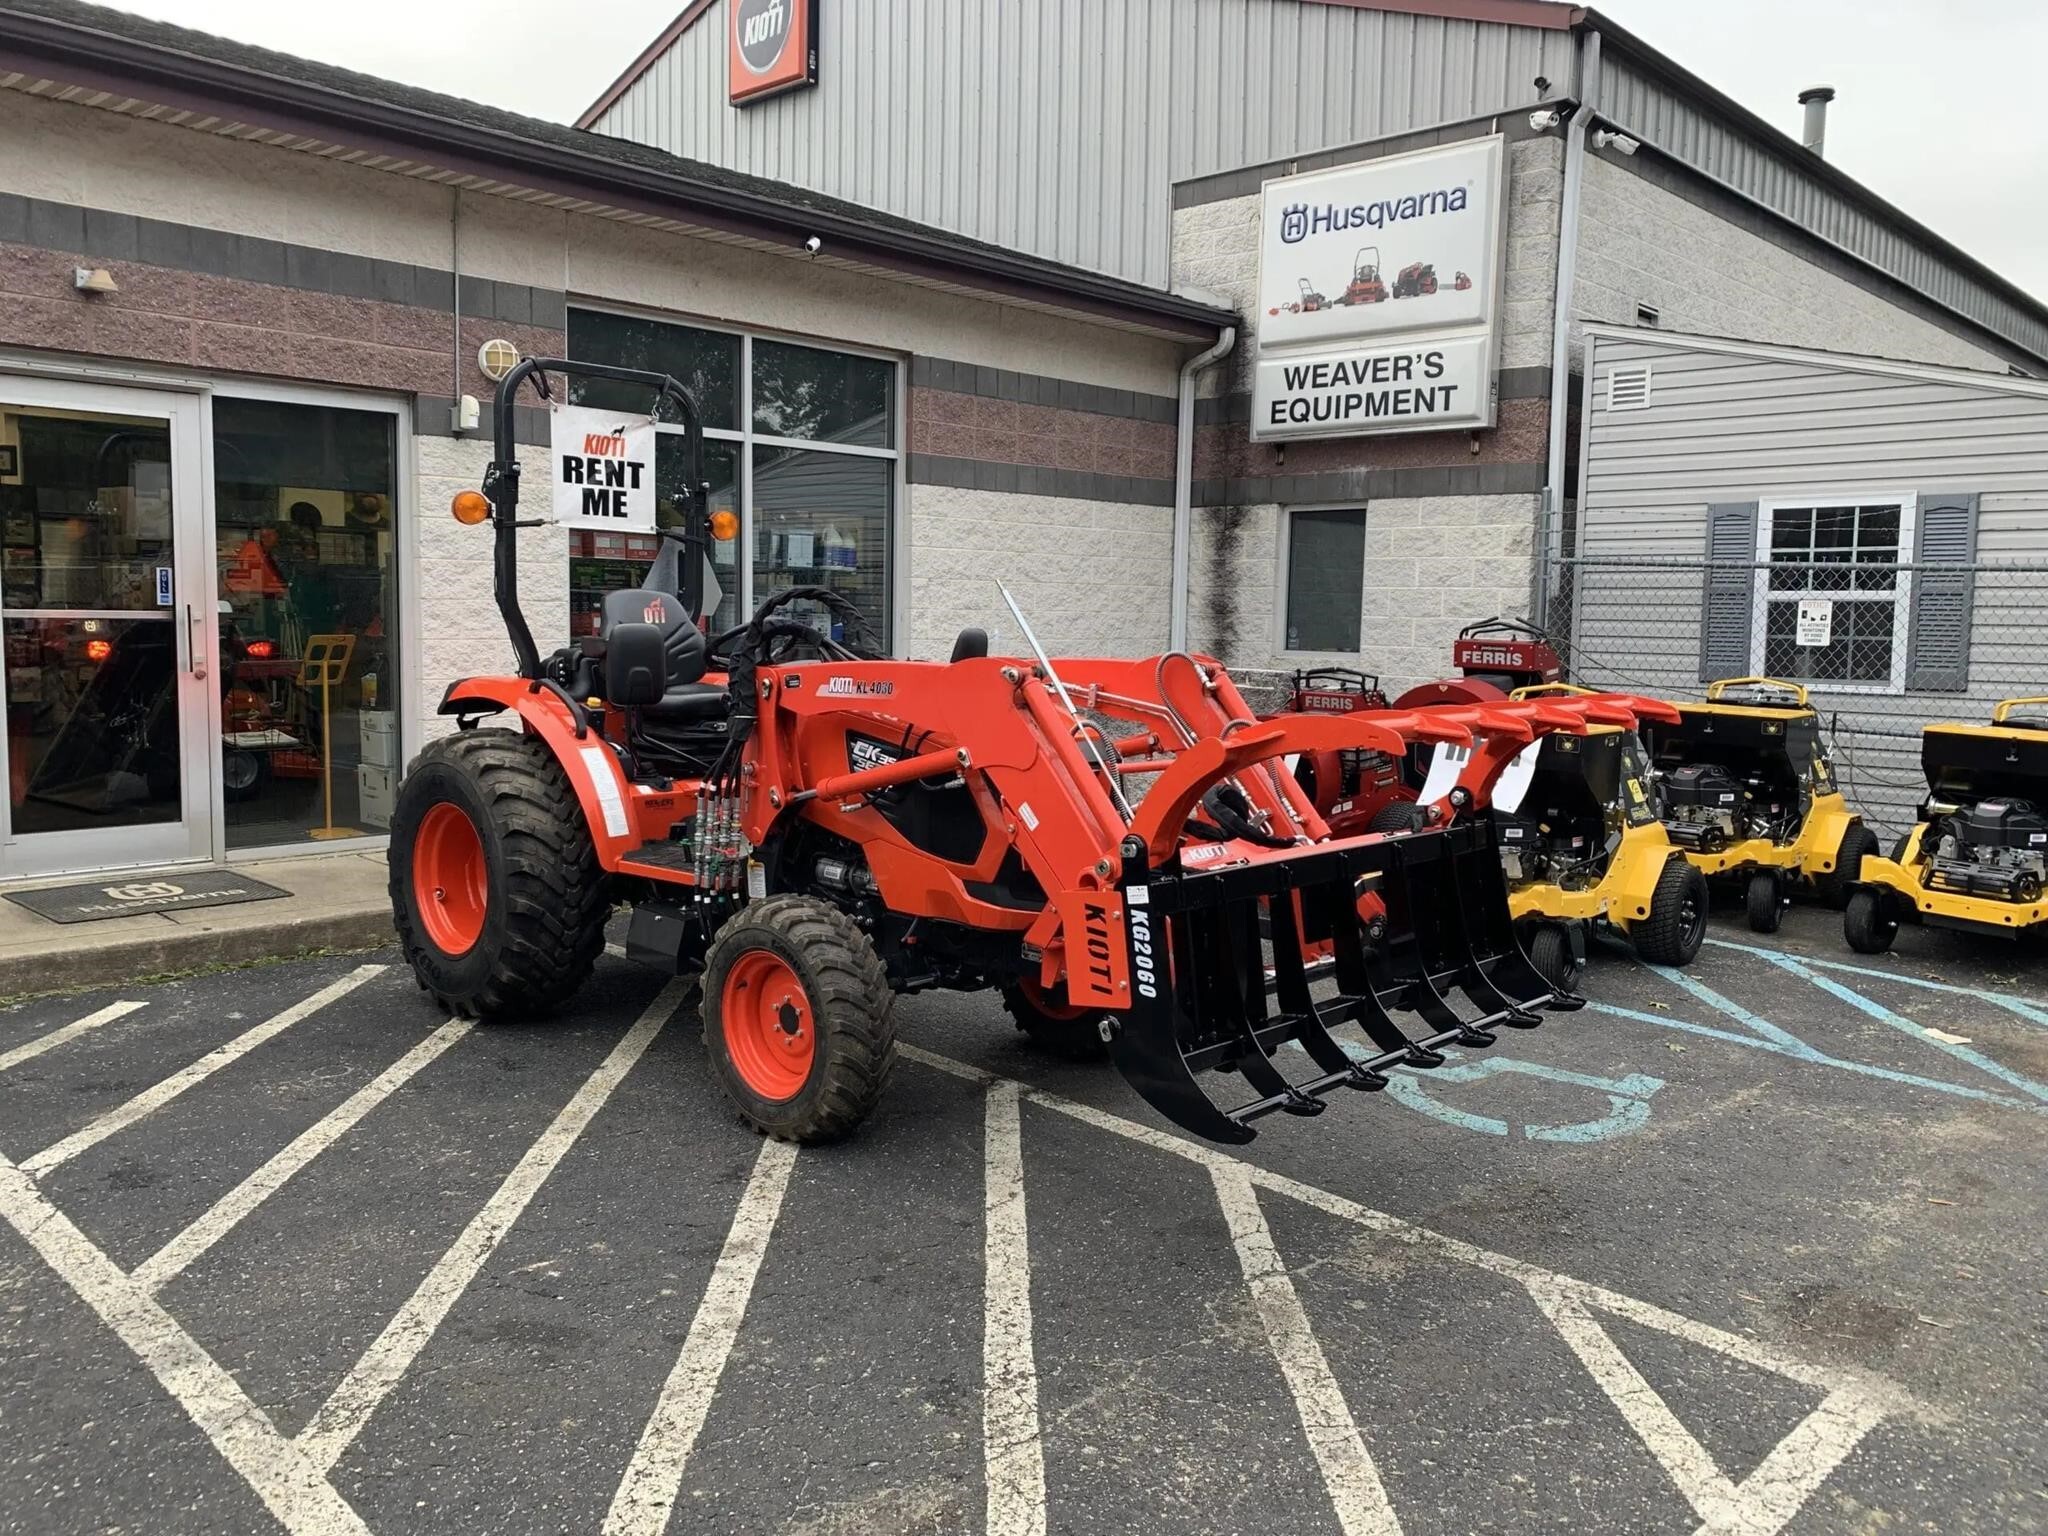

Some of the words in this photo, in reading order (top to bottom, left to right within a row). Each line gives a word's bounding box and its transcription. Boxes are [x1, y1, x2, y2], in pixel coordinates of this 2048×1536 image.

[744, 5, 783, 47] KIOTI
[1312, 187, 1467, 234] Husqvarna
[1283, 351, 1444, 391] WEAVER'S
[1271, 385, 1458, 424] EQUIPMENT
[584, 433, 626, 457] KIOTI
[563, 455, 645, 489] RENT
[582, 488, 628, 518] ME
[1462, 650, 1523, 666] FERRIS
[829, 677, 853, 693] KIOTI
[856, 681, 867, 694] KL
[1305, 695, 1353, 711] FERRIS
[1188, 844, 1228, 860] KIOTI
[78, 889, 247, 913] Husqvarna
[1084, 903, 1113, 996] KIOTI
[1130, 908, 1157, 998] KG2060
